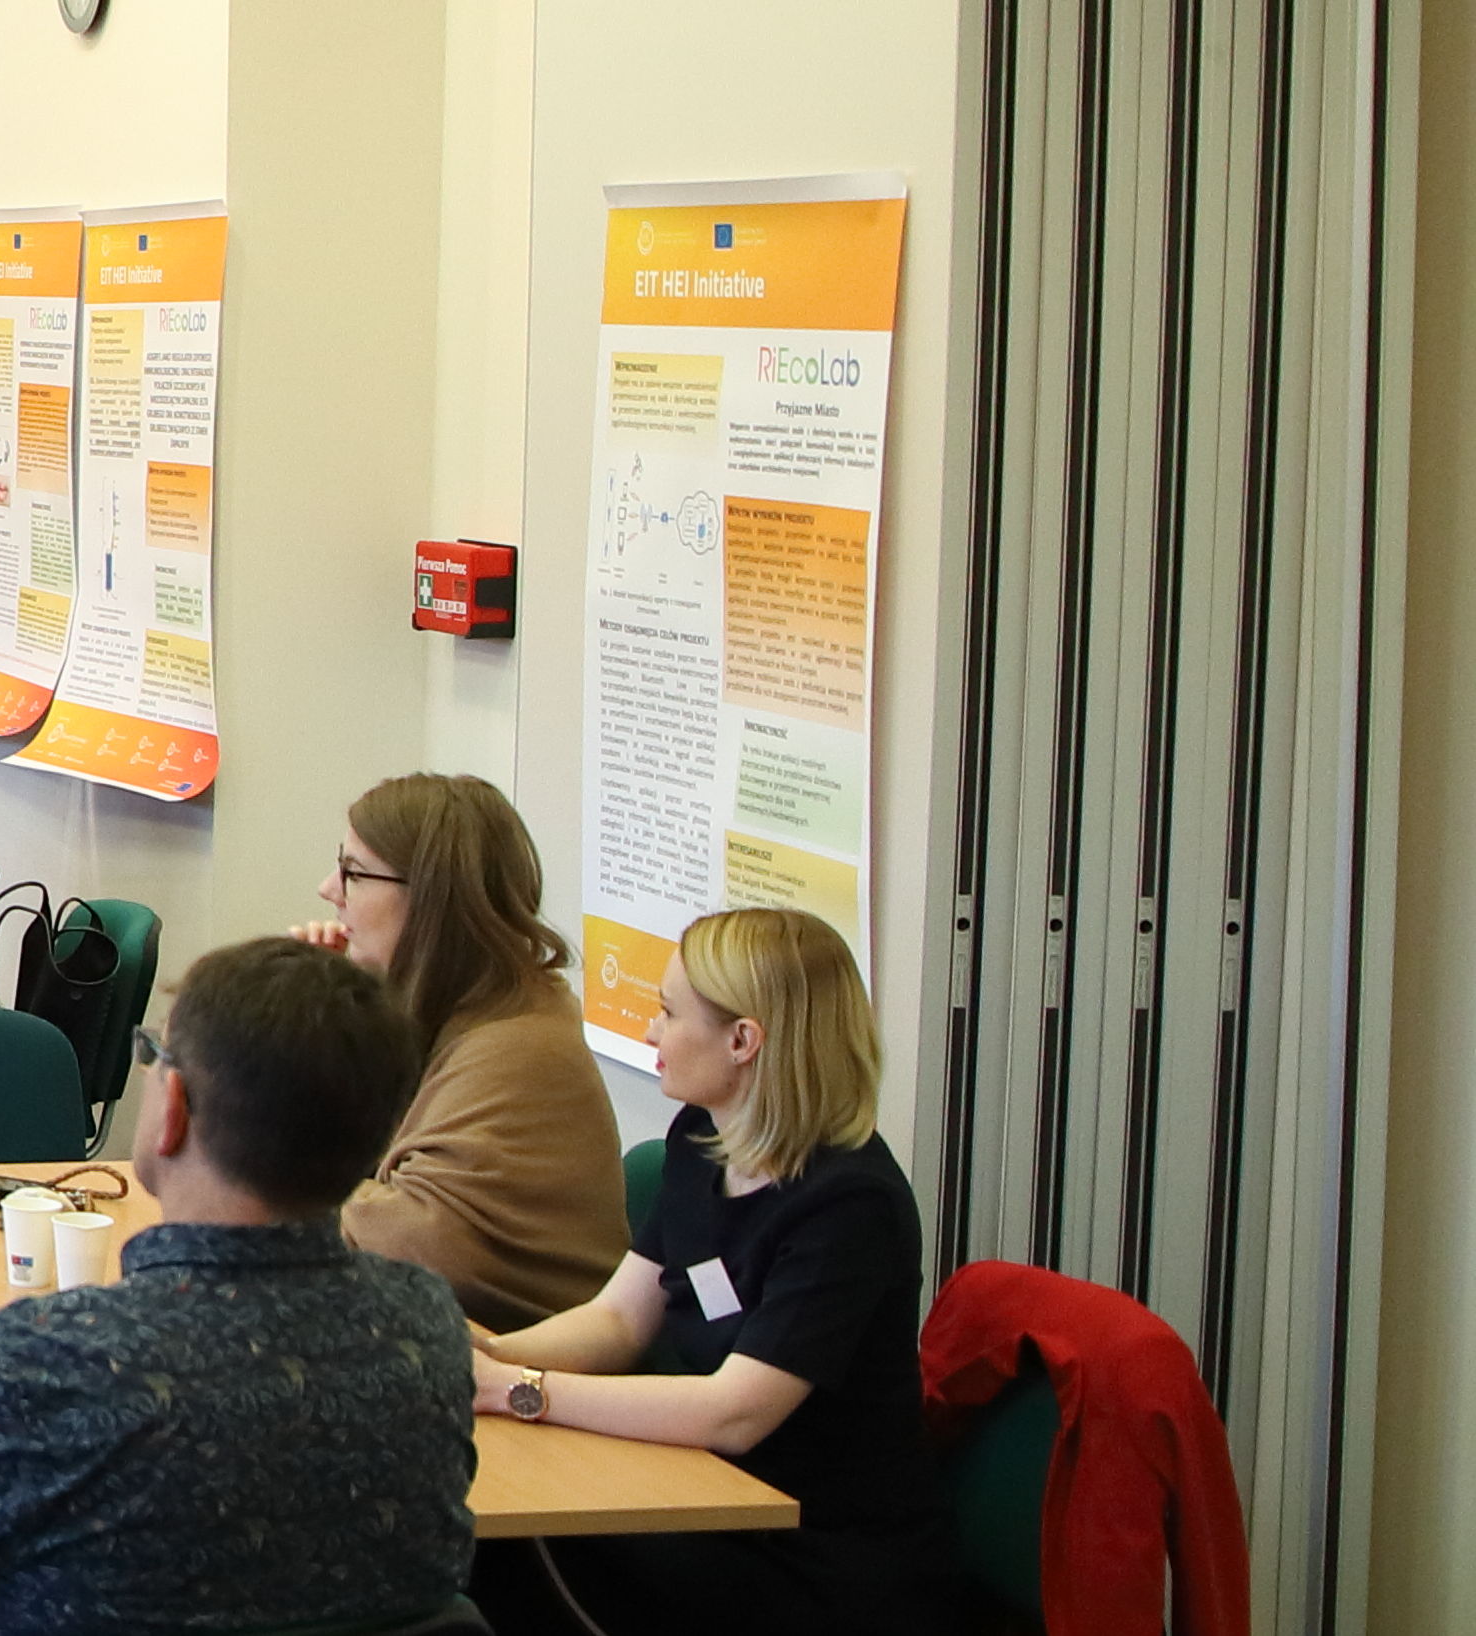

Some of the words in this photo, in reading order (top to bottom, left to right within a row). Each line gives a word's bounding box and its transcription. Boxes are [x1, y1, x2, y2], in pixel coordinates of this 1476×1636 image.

[5, 262, 33, 279] Initiative
[100, 267, 112, 285] EIT
[112, 267, 127, 284] HEI
[128, 265, 163, 284] Initiative
[635, 270, 659, 297] EIT
[662, 271, 689, 298] HEI
[693, 270, 765, 299] Initiative
[29, 307, 68, 331] RiEcoLab
[159, 307, 207, 332] RiEcoLab
[758, 346, 861, 387] RiEcoLab
[775, 401, 813, 418] Przyjazne
[815, 403, 841, 418] Miasto
[417, 555, 446, 573] Pierwsza
[445, 558, 468, 576] Pomoc
[680, 633, 710, 647] PROJEKTU
